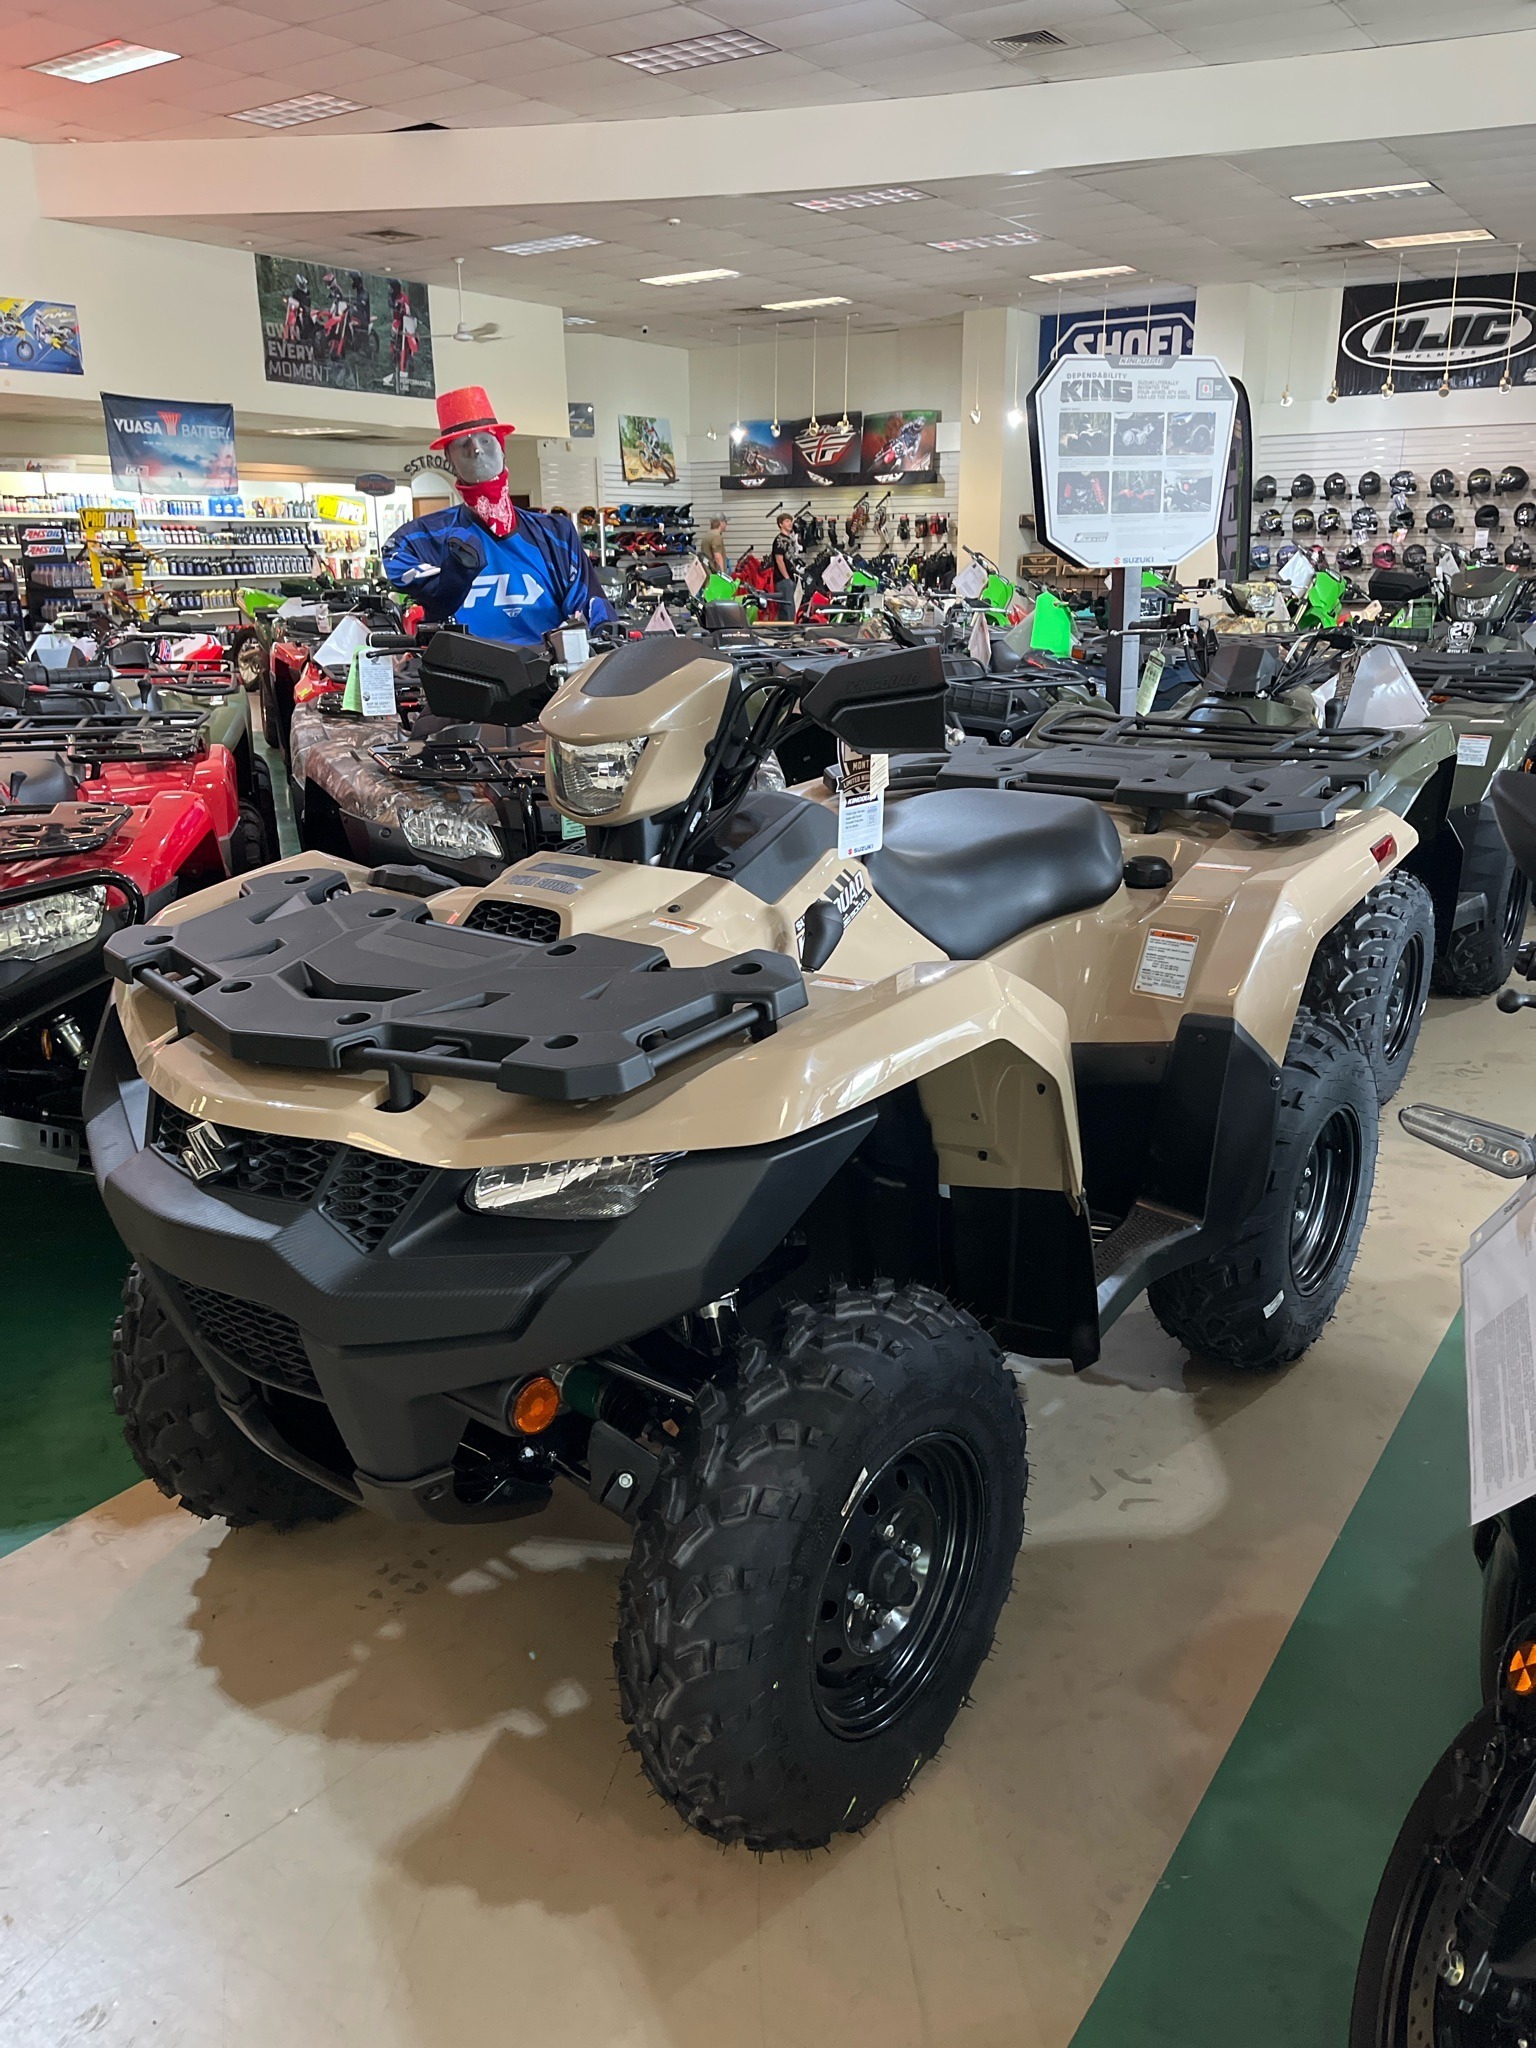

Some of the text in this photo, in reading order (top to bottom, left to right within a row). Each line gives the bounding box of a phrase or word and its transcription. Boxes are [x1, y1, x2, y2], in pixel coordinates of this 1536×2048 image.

[265, 321, 301, 341] OWN
[1368, 310, 1521, 356] HJC
[268, 341, 314, 361] EVERY
[1404, 350, 1477, 359] HELMETS
[268, 361, 332, 382] MOMENT
[1066, 372, 1127, 380] DEPENDABILITY
[1060, 379, 1133, 403] KING
[114, 418, 163, 435] YUASA
[26, 529, 62, 540] AMSOIL
[28, 545, 64, 556] AMSOIL
[1122, 556, 1154, 564] SUZUKI
[853, 844, 873, 853] SUZUKI
